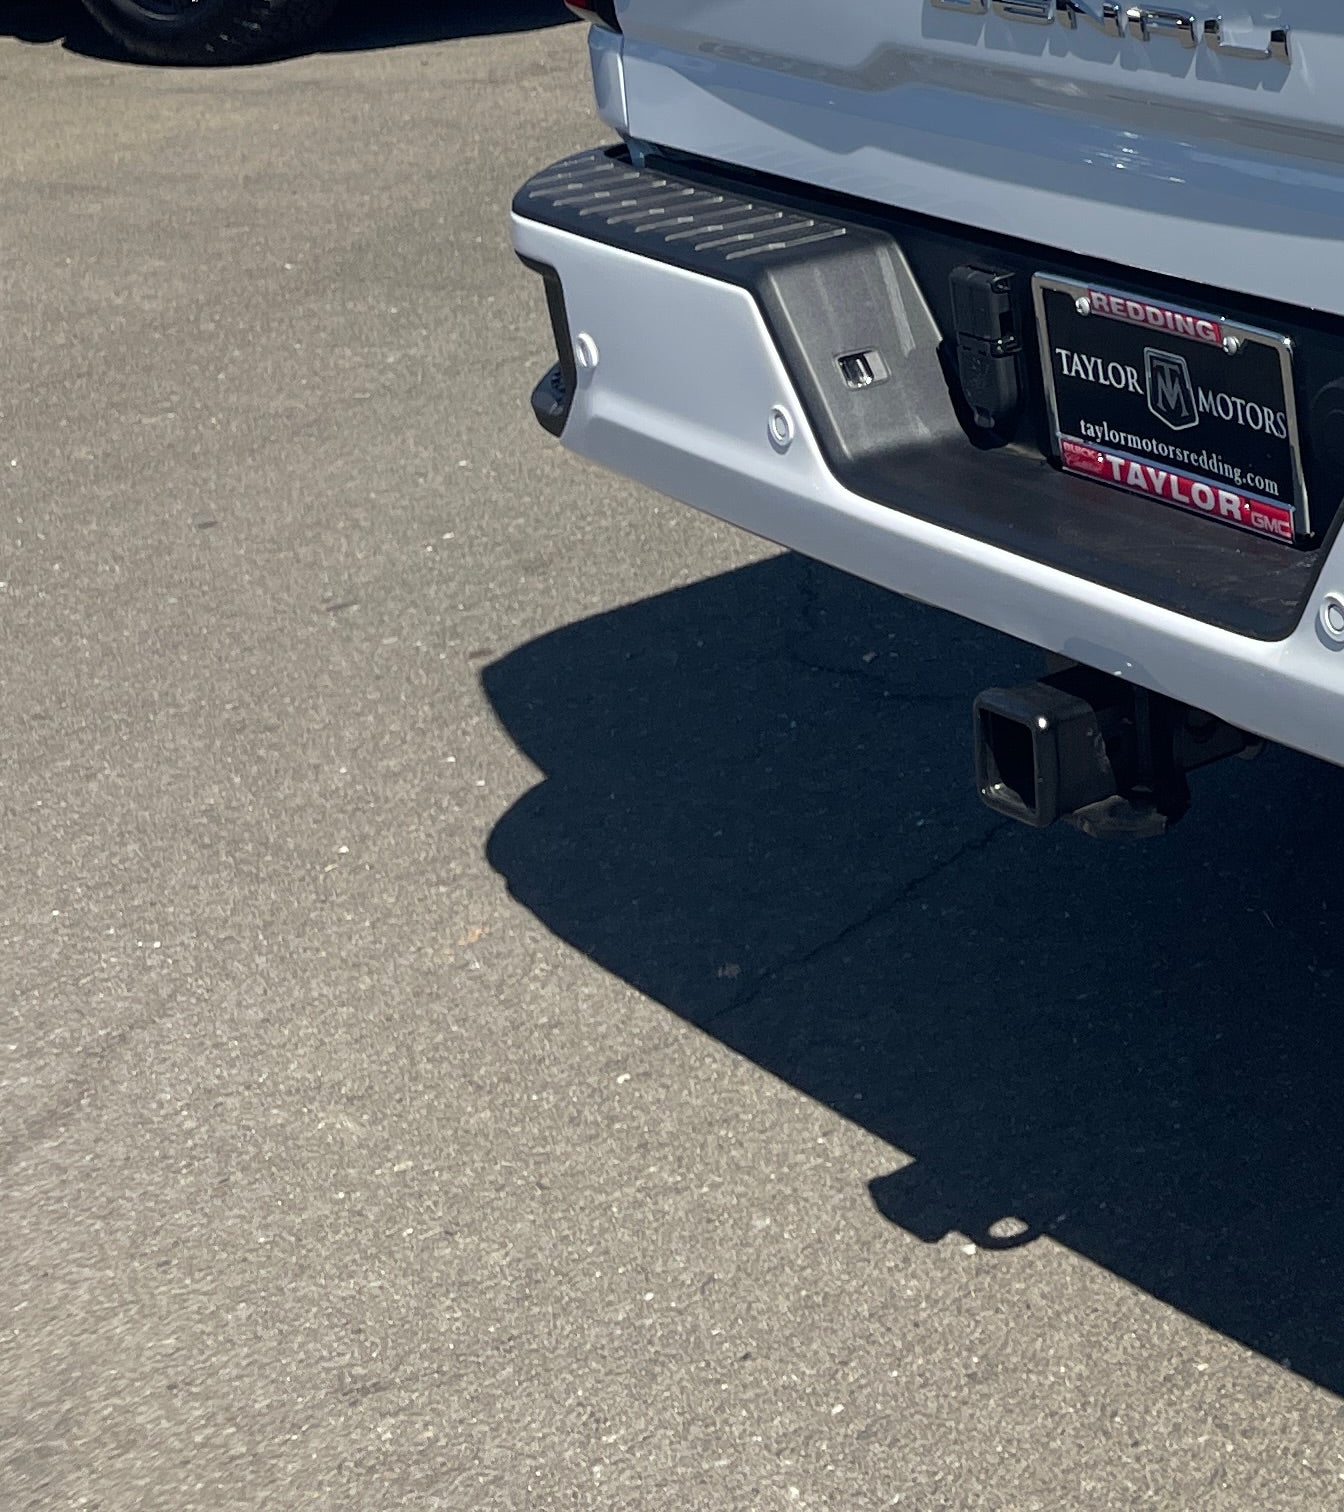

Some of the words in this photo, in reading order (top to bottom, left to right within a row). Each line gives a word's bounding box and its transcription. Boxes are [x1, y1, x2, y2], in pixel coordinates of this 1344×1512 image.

[1090, 291, 1217, 341] REDDING
[1056, 348, 1144, 395] TAYLOR
[1198, 387, 1287, 439] MOTORS
[1080, 419, 1279, 496] taylormotorsredding.com
[1106, 454, 1242, 521] TAYLOR
[1251, 512, 1291, 537] GMC
